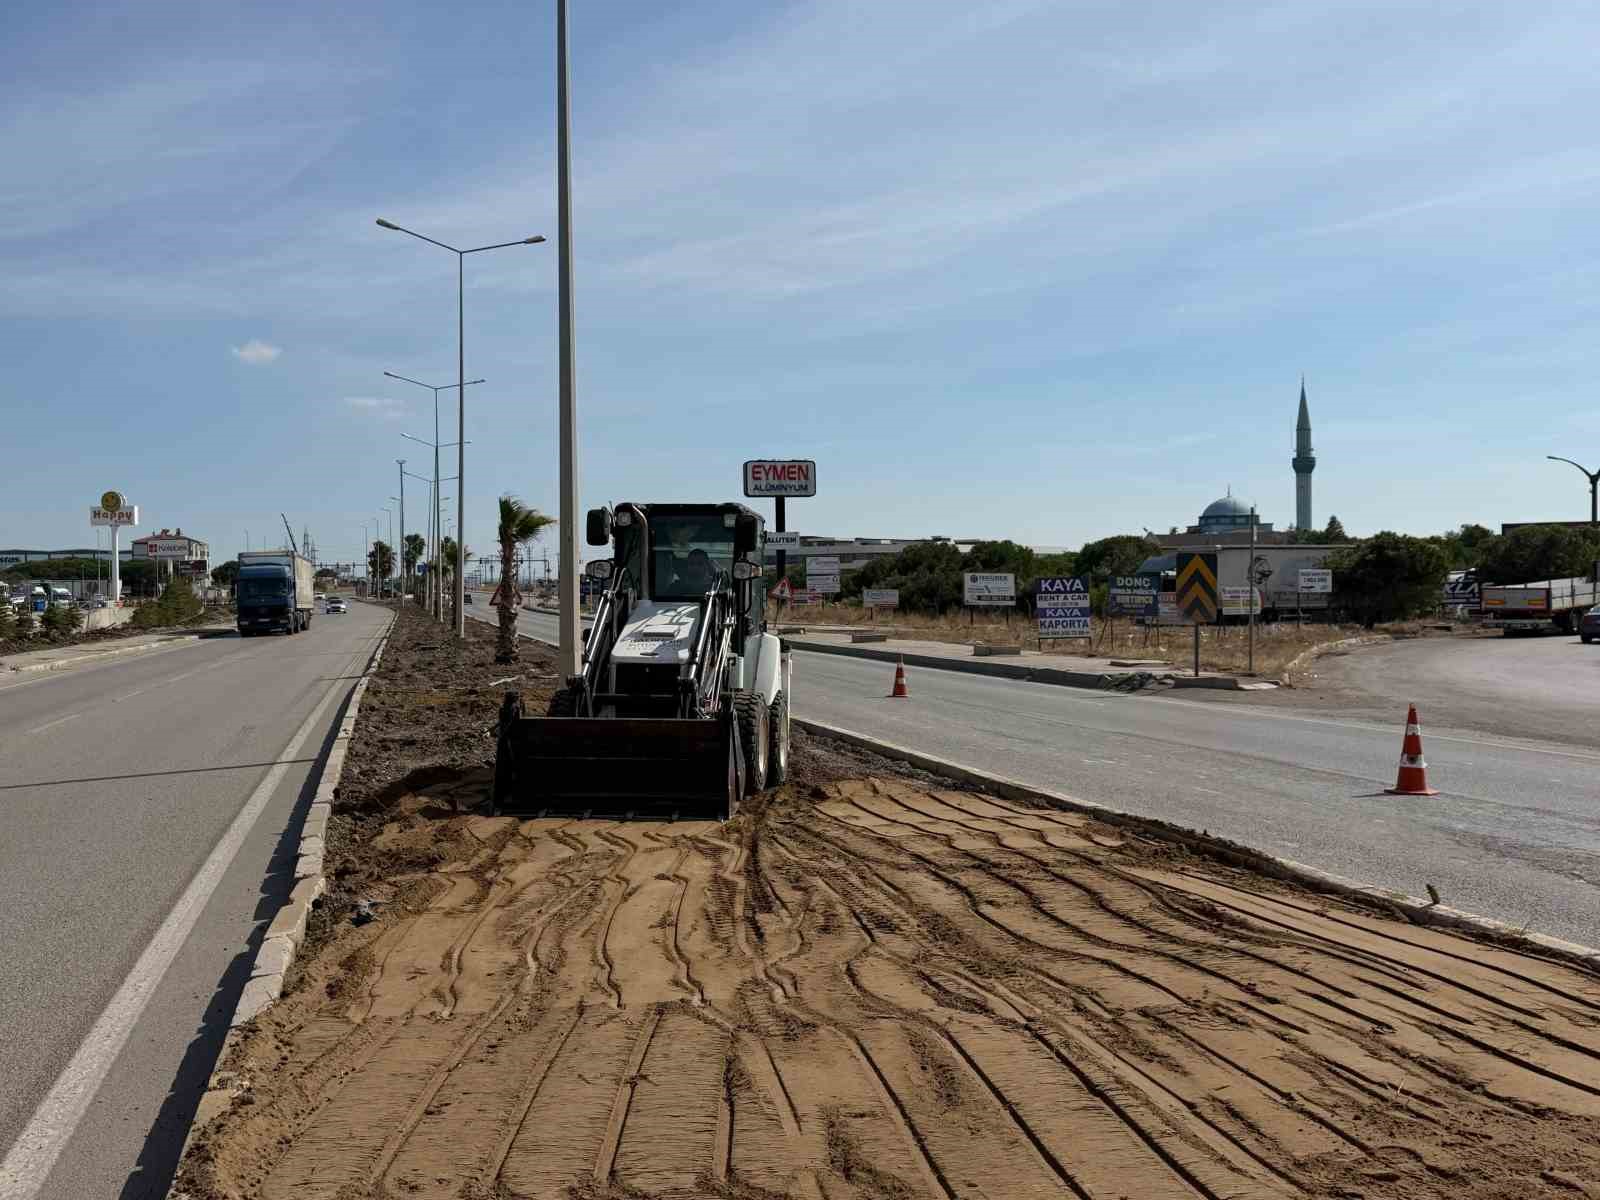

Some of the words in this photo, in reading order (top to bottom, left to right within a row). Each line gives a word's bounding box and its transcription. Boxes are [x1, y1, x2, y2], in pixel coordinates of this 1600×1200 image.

[752, 464, 809, 481] EYMEN
[93, 510, 132, 521] Happy
[1040, 579, 1085, 591] KAYA
[1046, 608, 1081, 617] KAYA
[1040, 620, 1089, 629] KAPORTA
